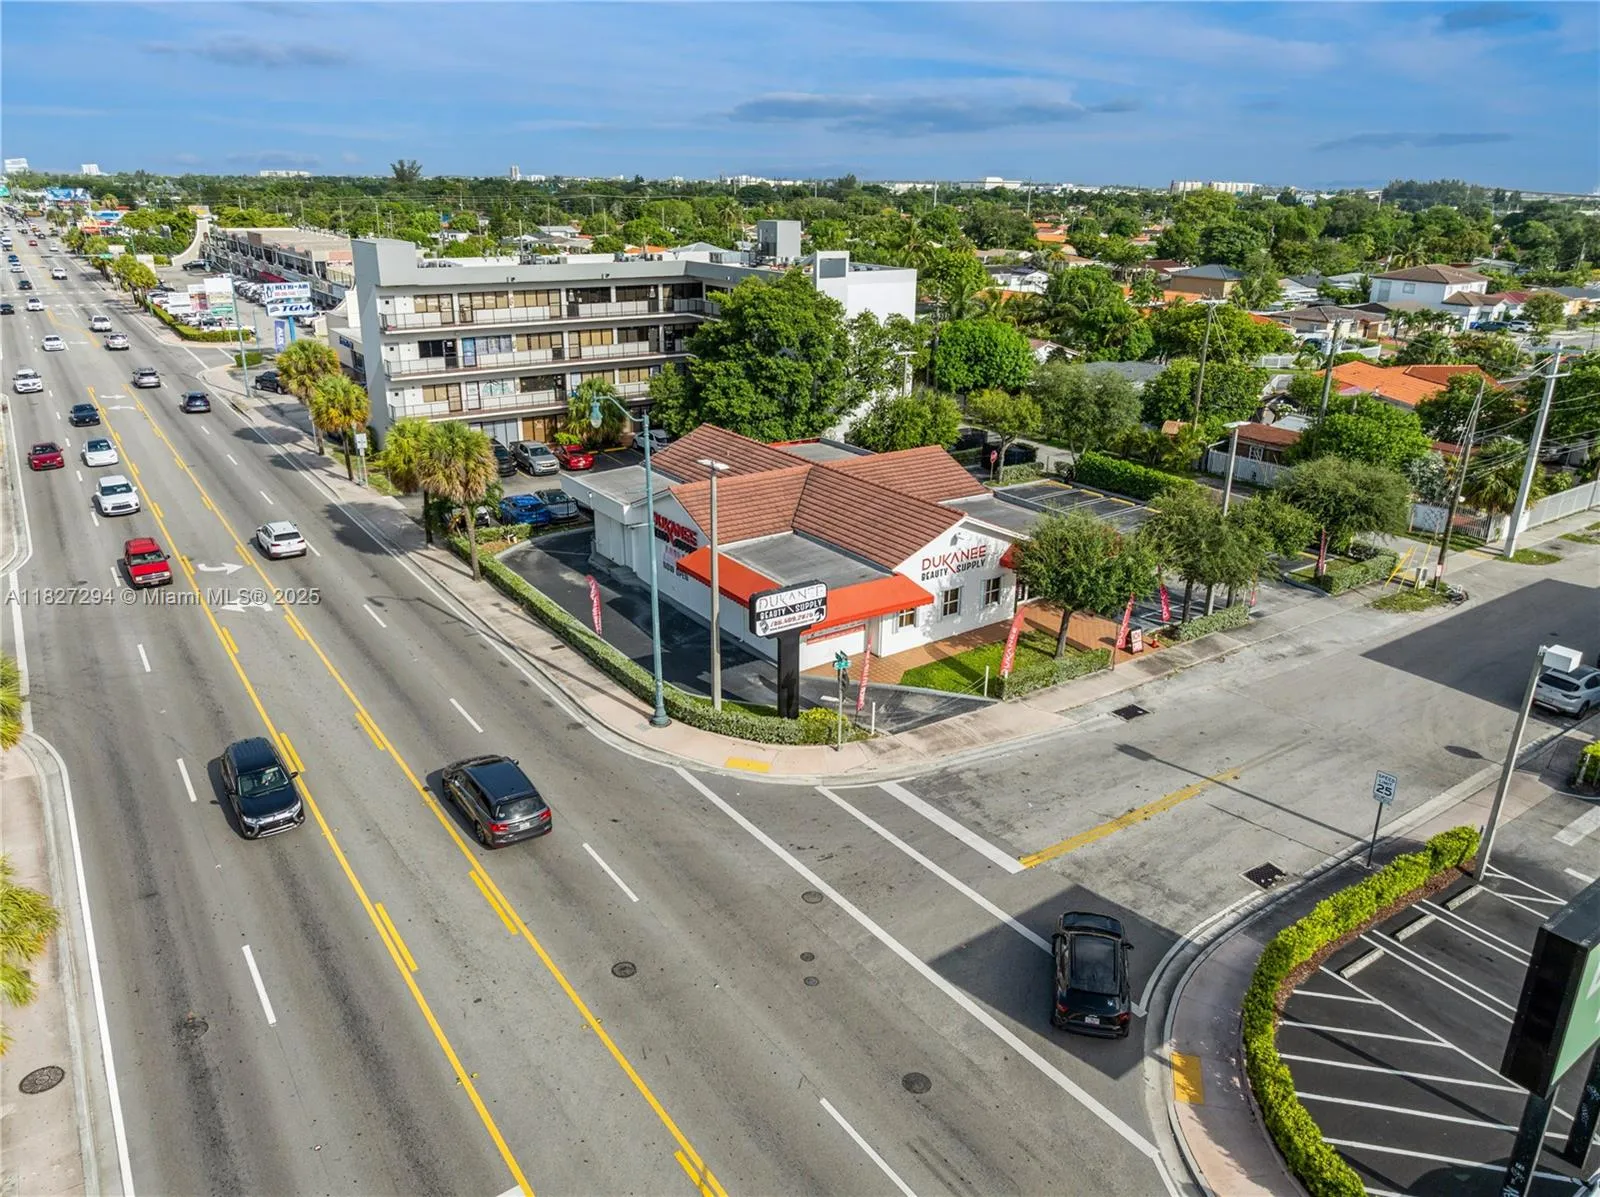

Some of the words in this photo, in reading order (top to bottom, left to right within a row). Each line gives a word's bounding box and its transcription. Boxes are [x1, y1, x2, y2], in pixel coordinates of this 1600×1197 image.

[921, 545, 987, 574] DUKANEE
[921, 567, 949, 581] BEAUTY
[956, 559, 987, 573] SUPPLY
[760, 608, 786, 620] BEAUTY
[795, 599, 823, 612] SUPPLY
[1376, 783, 1393, 797] 25
